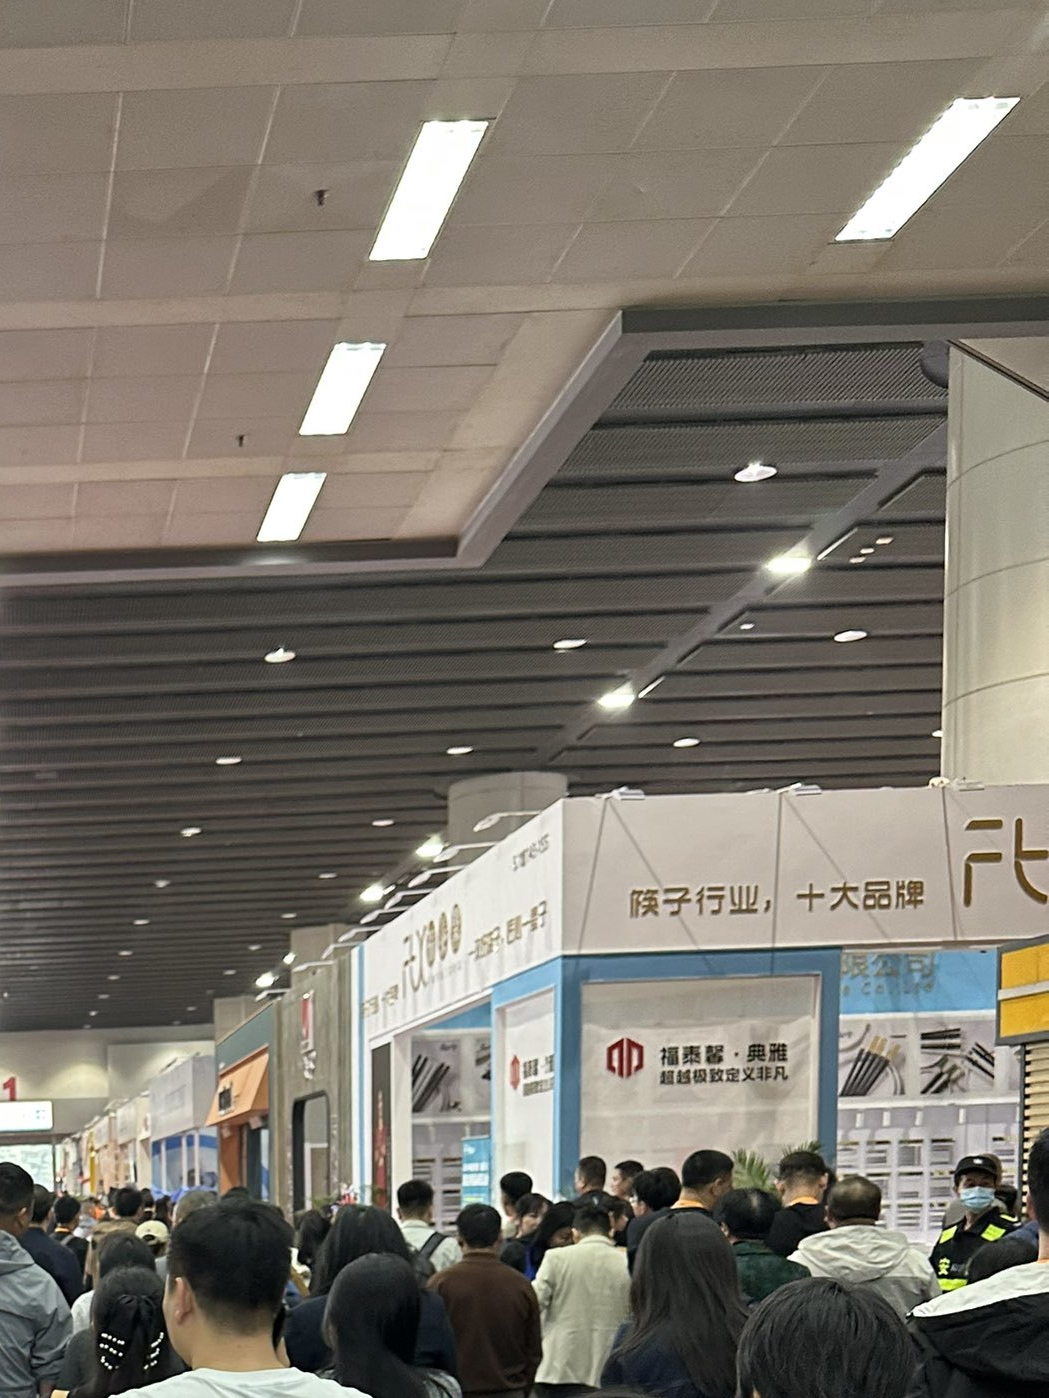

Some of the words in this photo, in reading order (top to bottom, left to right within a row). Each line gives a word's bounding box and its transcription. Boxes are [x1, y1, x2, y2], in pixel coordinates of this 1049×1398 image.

[659, 1066, 789, 1086] 超越极致定义非凡
